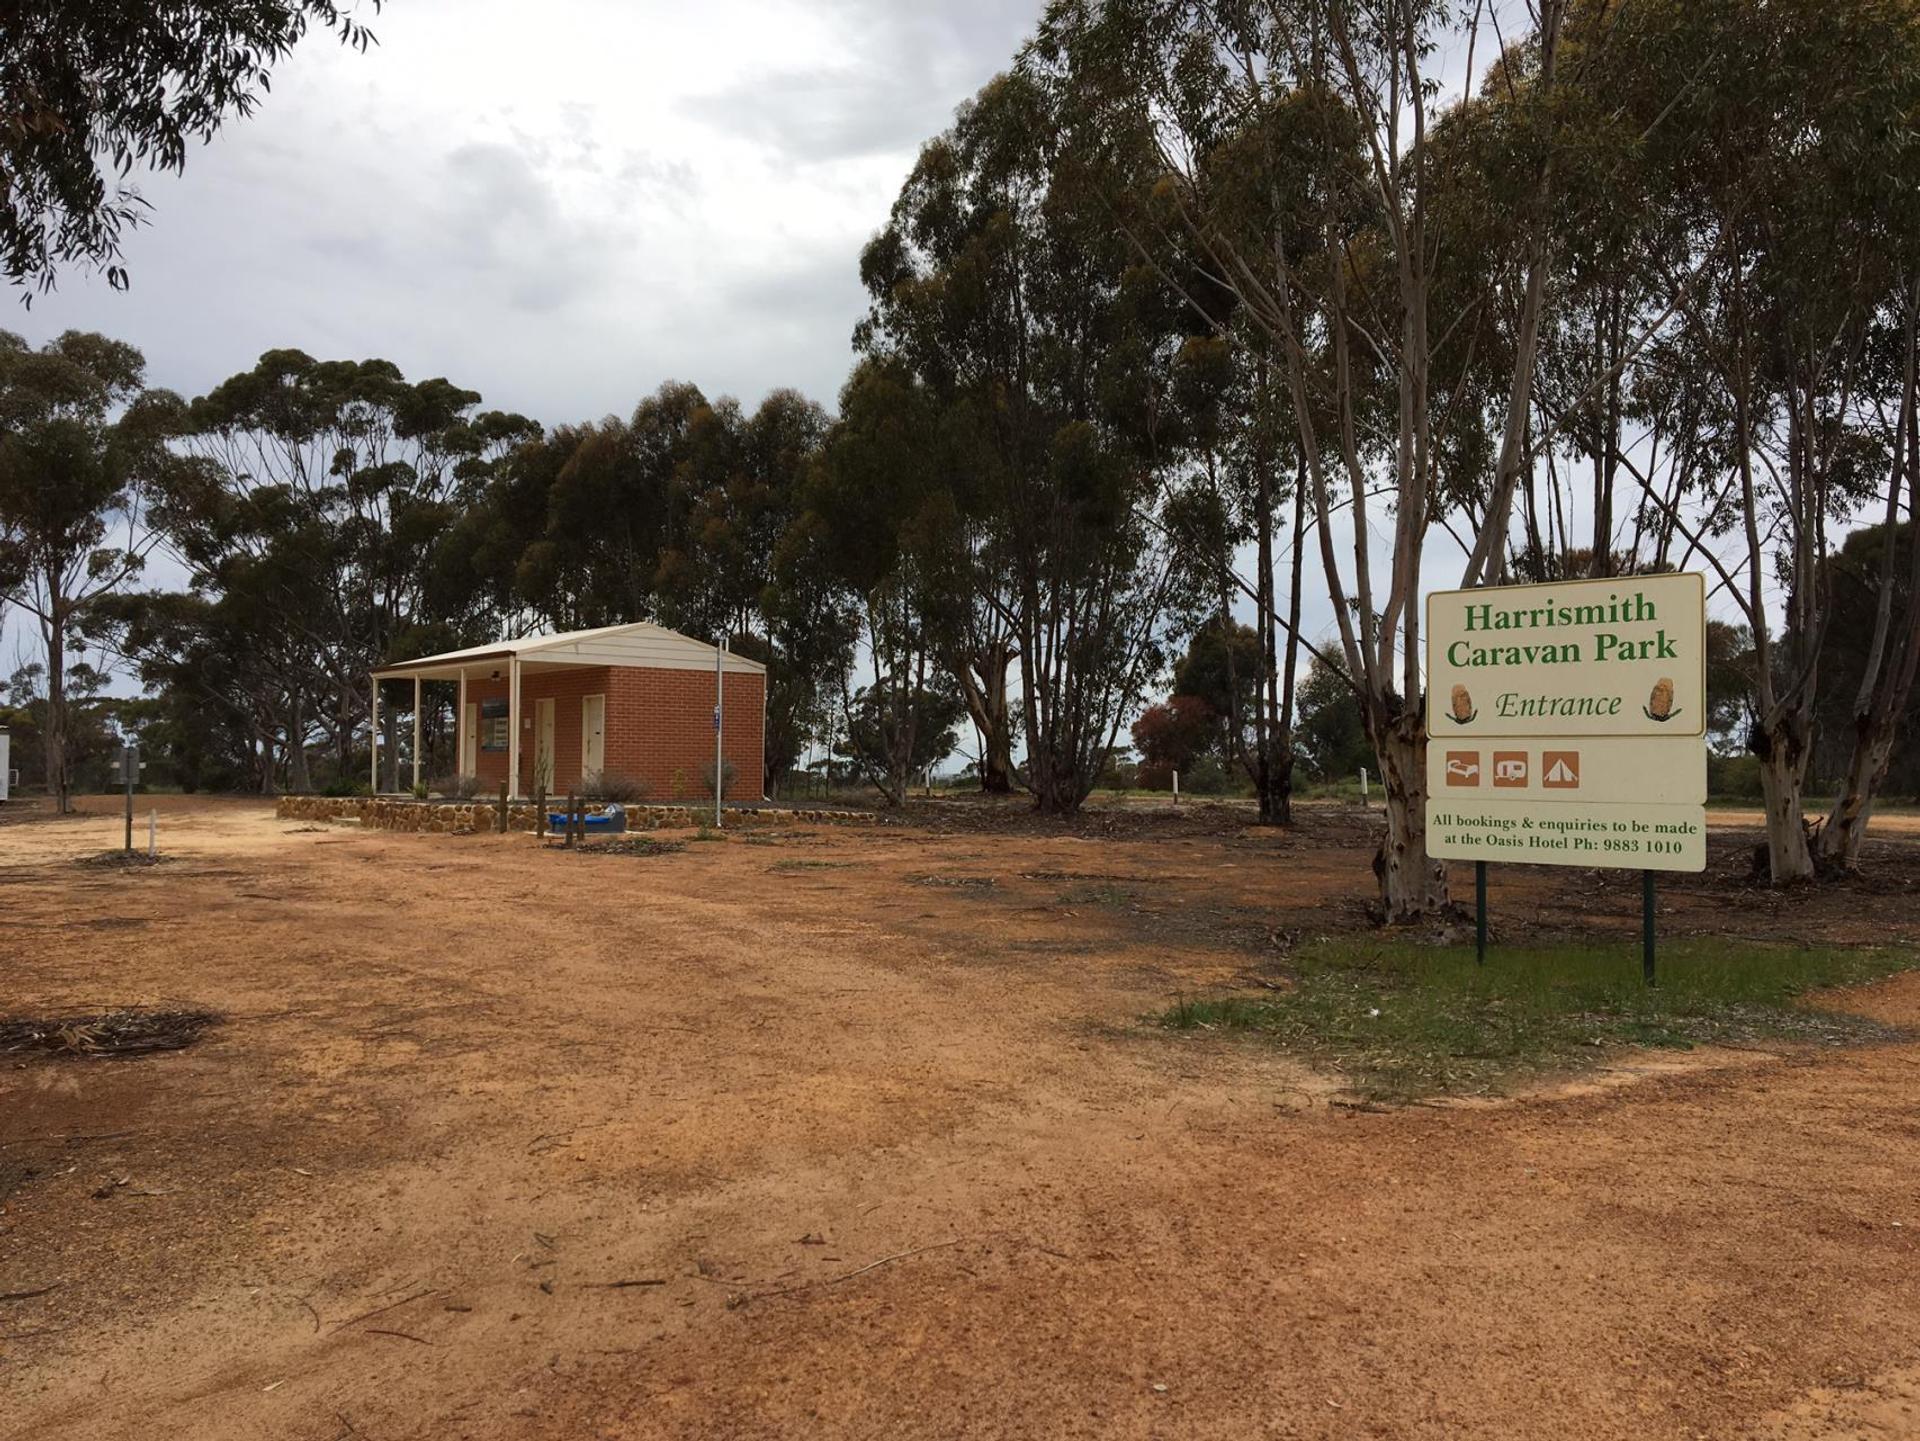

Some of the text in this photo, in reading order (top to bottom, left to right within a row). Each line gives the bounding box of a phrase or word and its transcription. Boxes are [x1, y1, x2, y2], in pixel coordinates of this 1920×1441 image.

[1465, 592, 1657, 632] Harrismith
[1447, 630, 1677, 667] Caravan Park
[1496, 693, 1621, 717] Entrance
[1433, 815, 1697, 834] All bookings & enquiries to be made
[1445, 834, 1682, 853] at the Oasis Hotel Ph: 9883 1010
